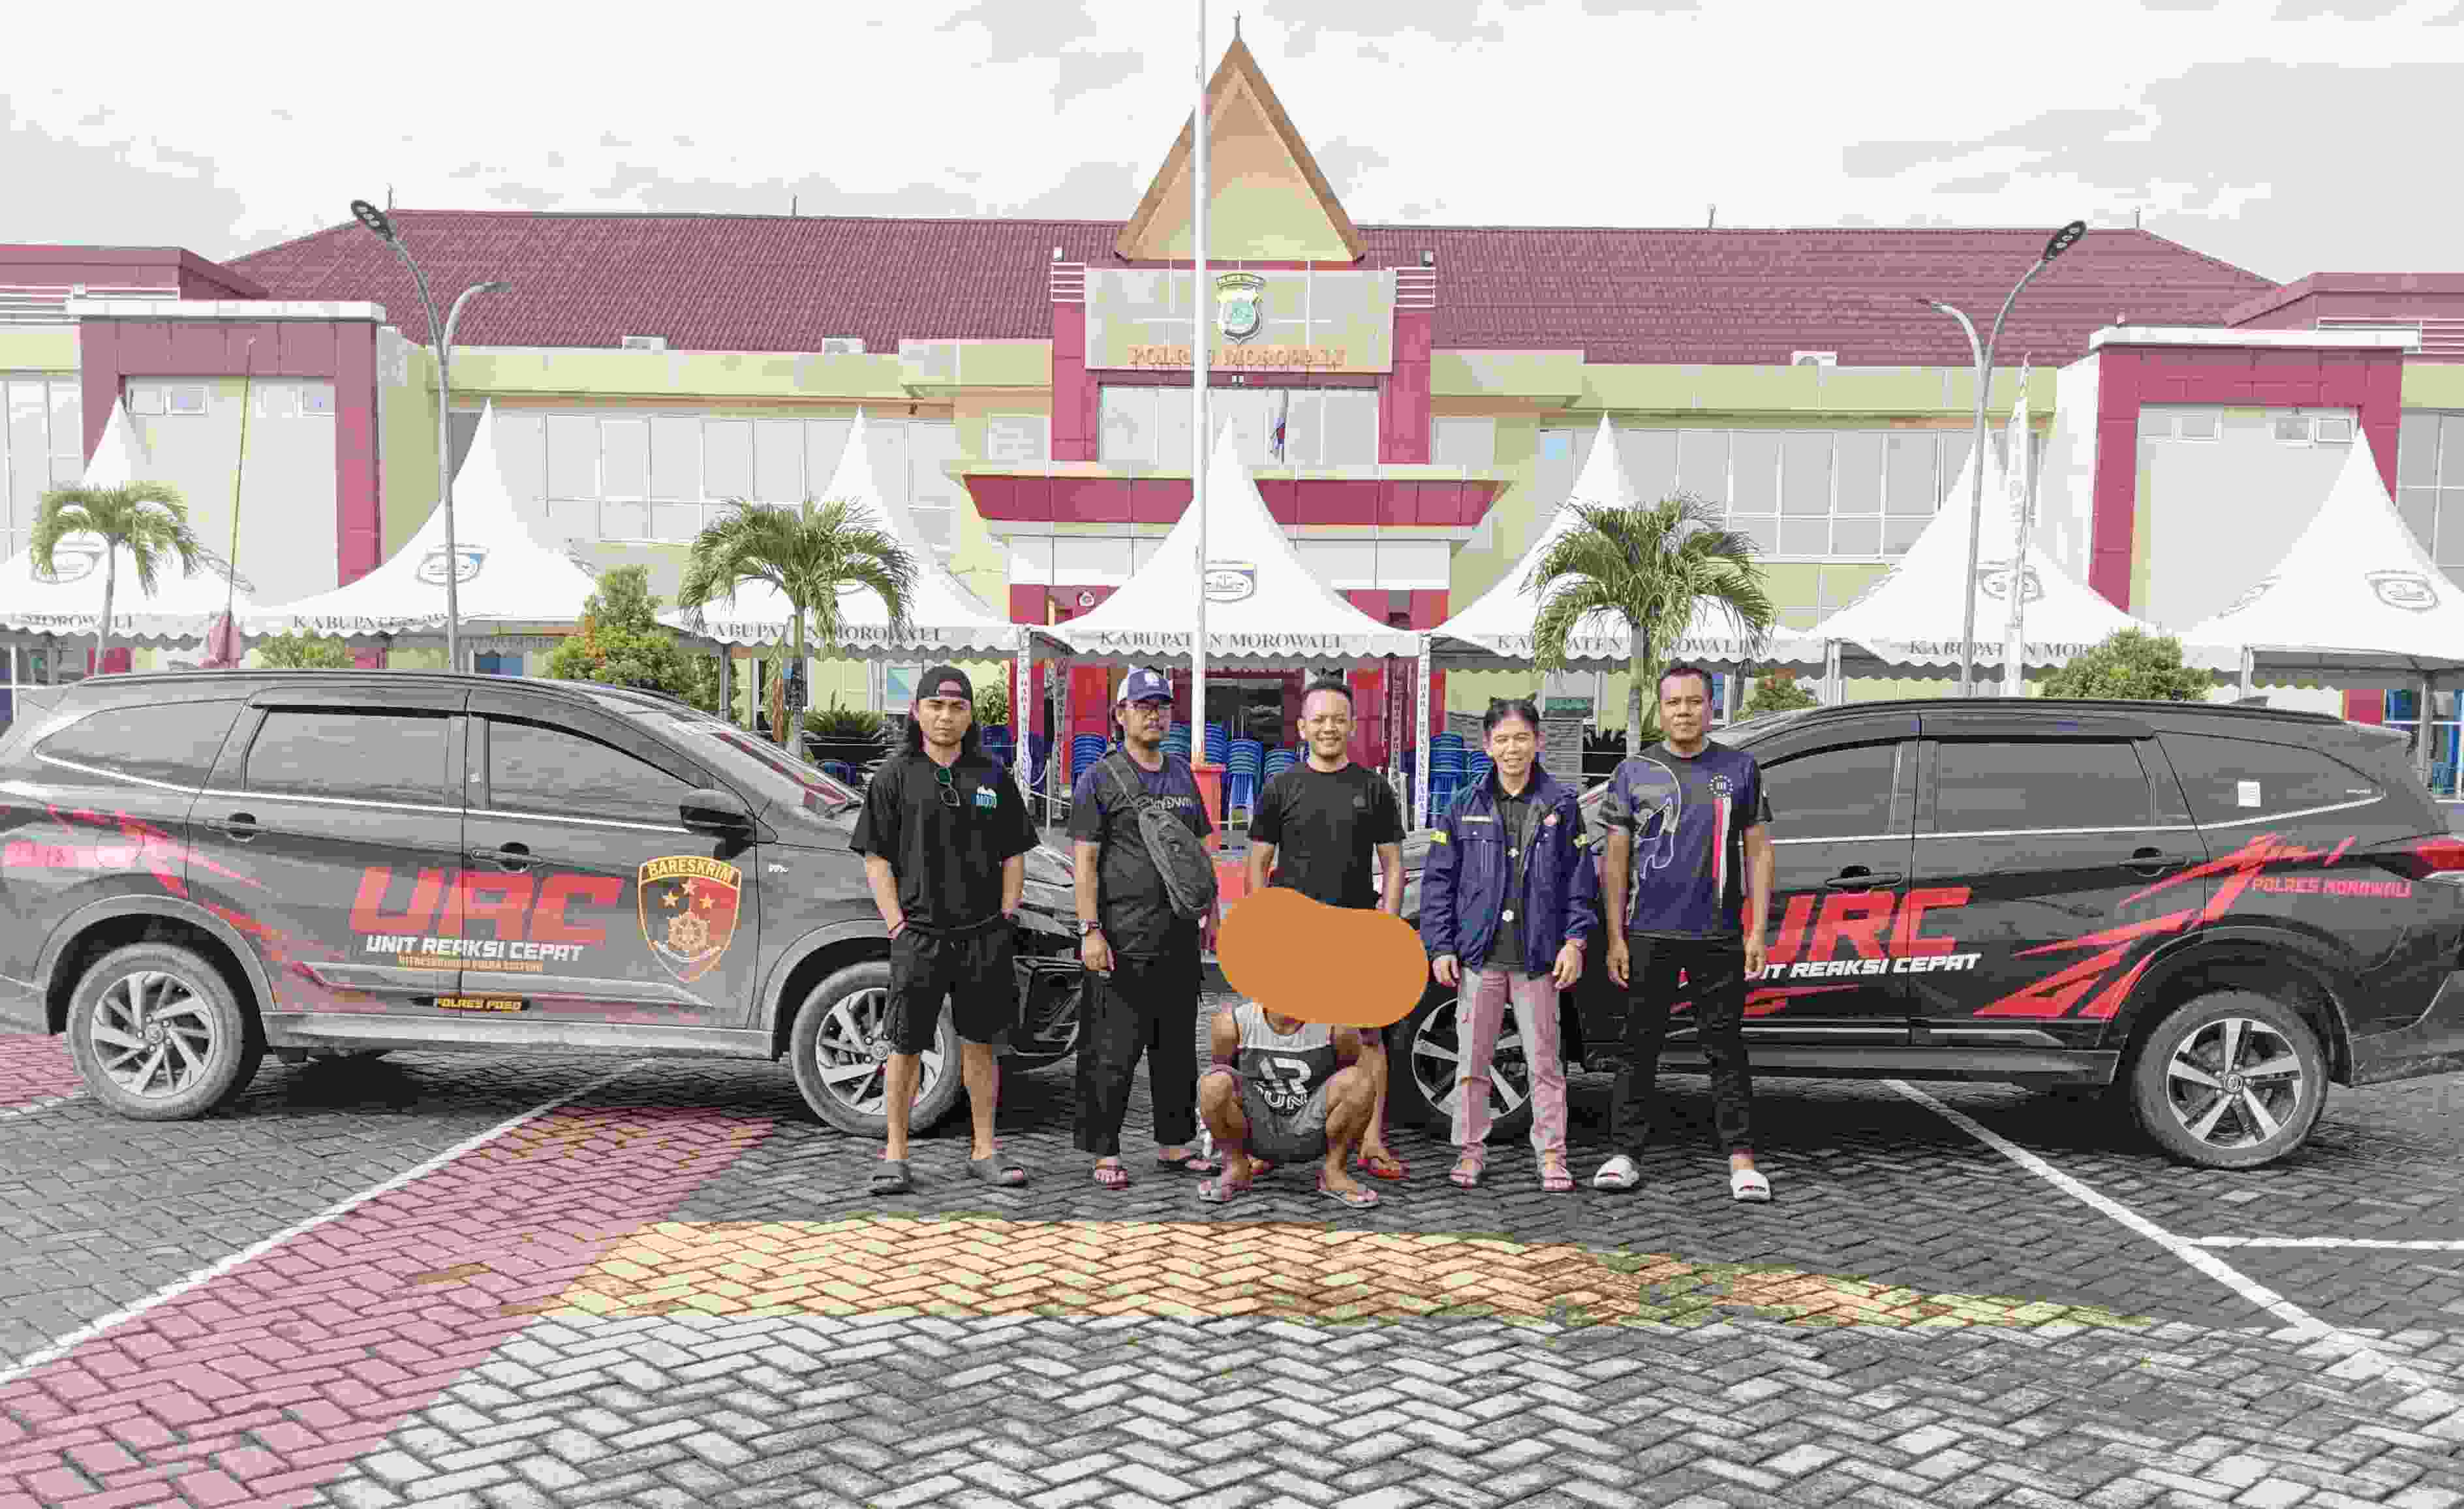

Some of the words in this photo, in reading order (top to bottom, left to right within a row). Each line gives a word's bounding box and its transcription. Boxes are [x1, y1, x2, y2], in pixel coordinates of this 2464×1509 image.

[1130, 348, 1216, 368] POLRS
[1101, 631, 1222, 648] KABUPATN
[1229, 633, 1341, 649] MOROWALI
[647, 859, 734, 882] BARESKRIM
[365, 935, 418, 955] UNIT
[422, 938, 506, 959] REAKSI
[510, 942, 584, 961] CEPAT
[1791, 957, 1888, 978] REAKSI
[1894, 953, 1981, 973] CEPAT
